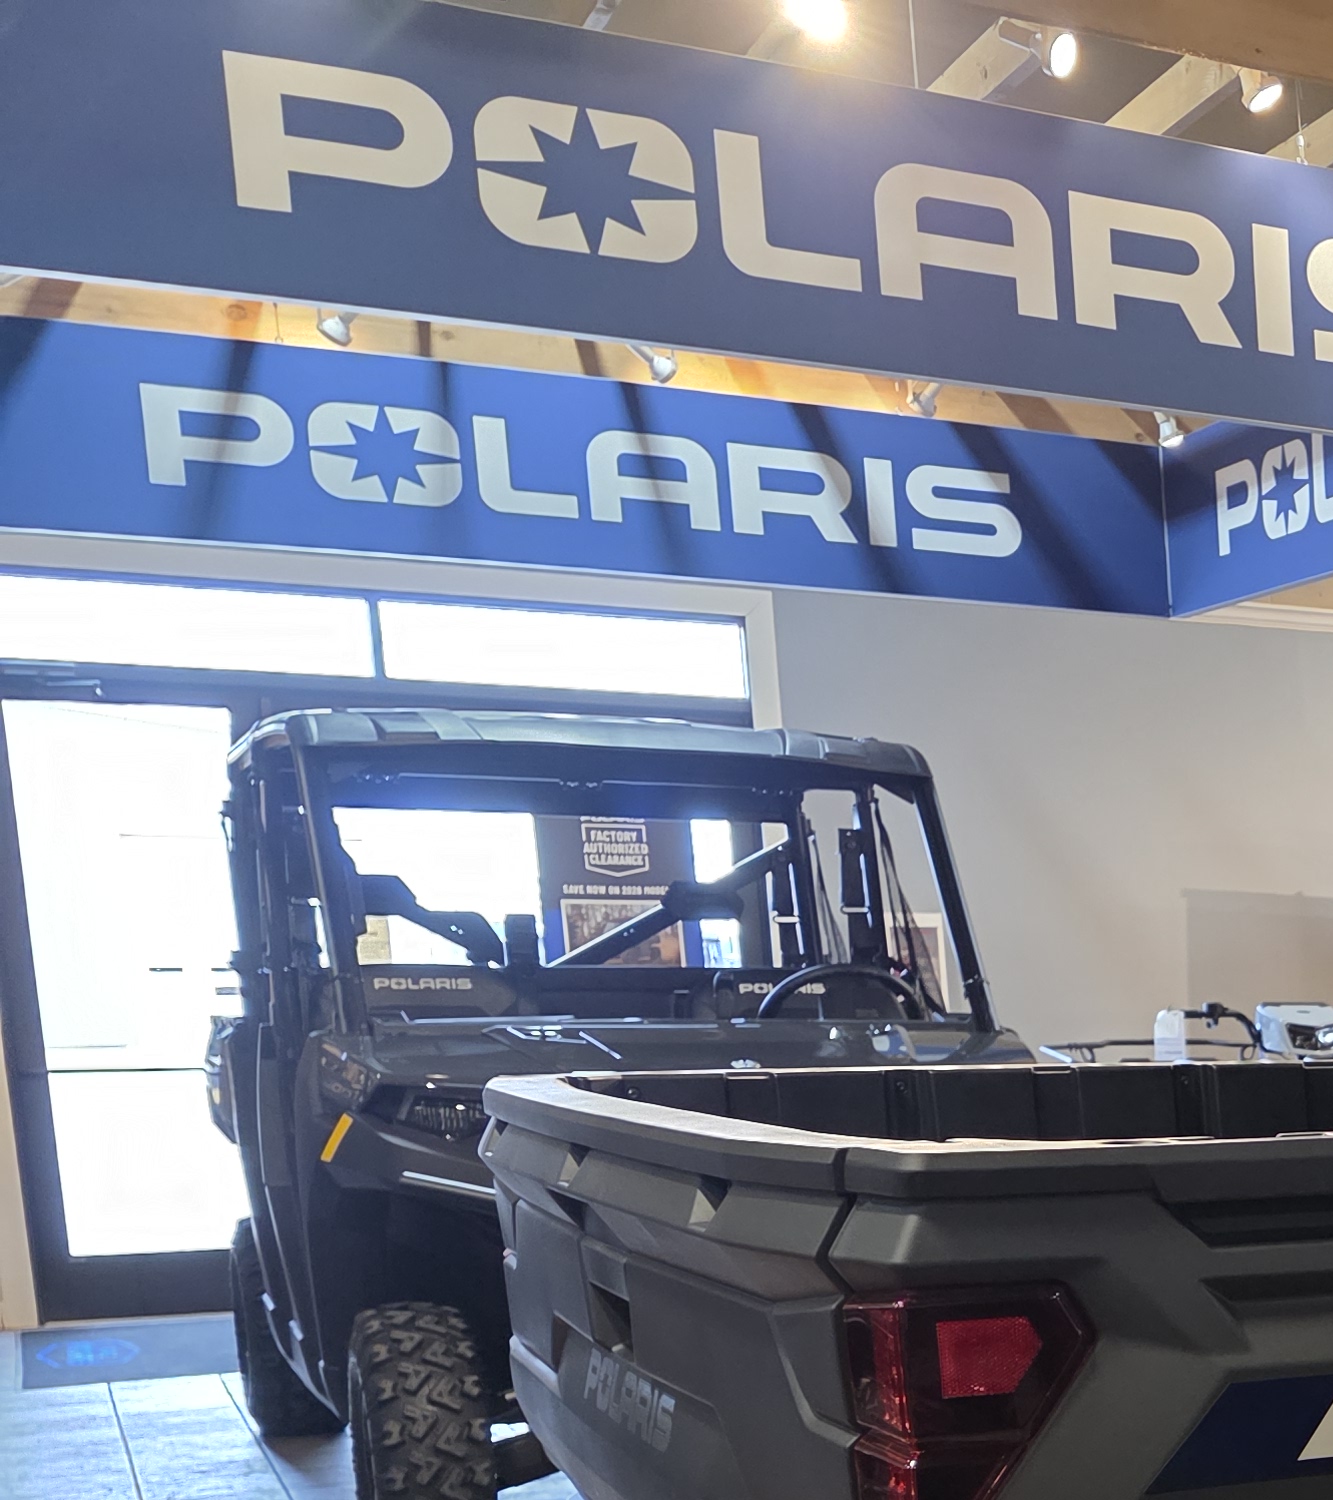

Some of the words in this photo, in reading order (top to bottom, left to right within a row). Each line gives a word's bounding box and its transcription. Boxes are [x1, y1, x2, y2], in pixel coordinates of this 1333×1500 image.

[139, 382, 1023, 558] POLARIS
[590, 829, 638, 843] FACTORY
[582, 841, 649, 855] AUTHORIZED
[588, 854, 645, 866] CLEARANCE
[562, 884, 585, 895] SAVE
[373, 977, 473, 991] POLARIS
[583, 1346, 677, 1454] POLARIS
